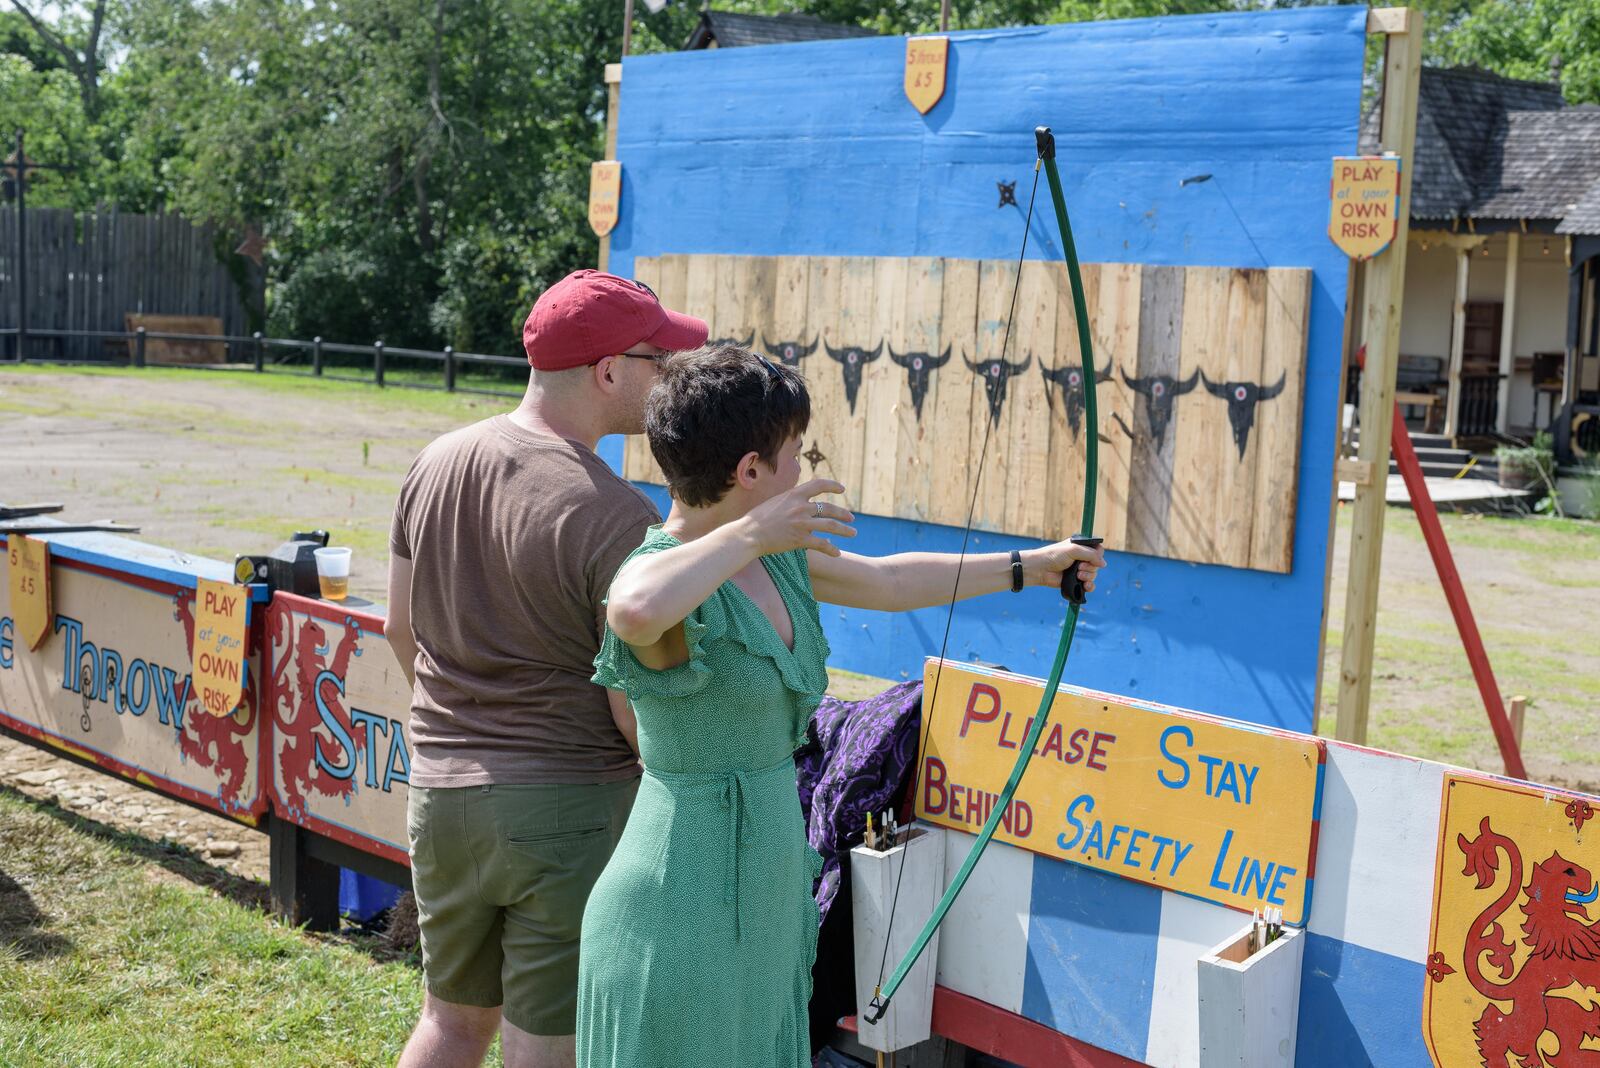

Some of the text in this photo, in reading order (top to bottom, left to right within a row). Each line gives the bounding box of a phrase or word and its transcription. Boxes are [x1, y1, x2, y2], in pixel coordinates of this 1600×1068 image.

[1342, 166, 1383, 181] PLAY
[1336, 186, 1390, 202] at your
[1340, 202, 1387, 219] OWN
[1341, 222, 1380, 239] RISK
[204, 591, 237, 618] PLAY
[199, 626, 241, 654] at your
[199, 652, 239, 683] OWN
[203, 686, 230, 713] RISK
[1156, 724, 1261, 806] STAY
[923, 755, 1298, 906] BEHIND SAFETY LINE
